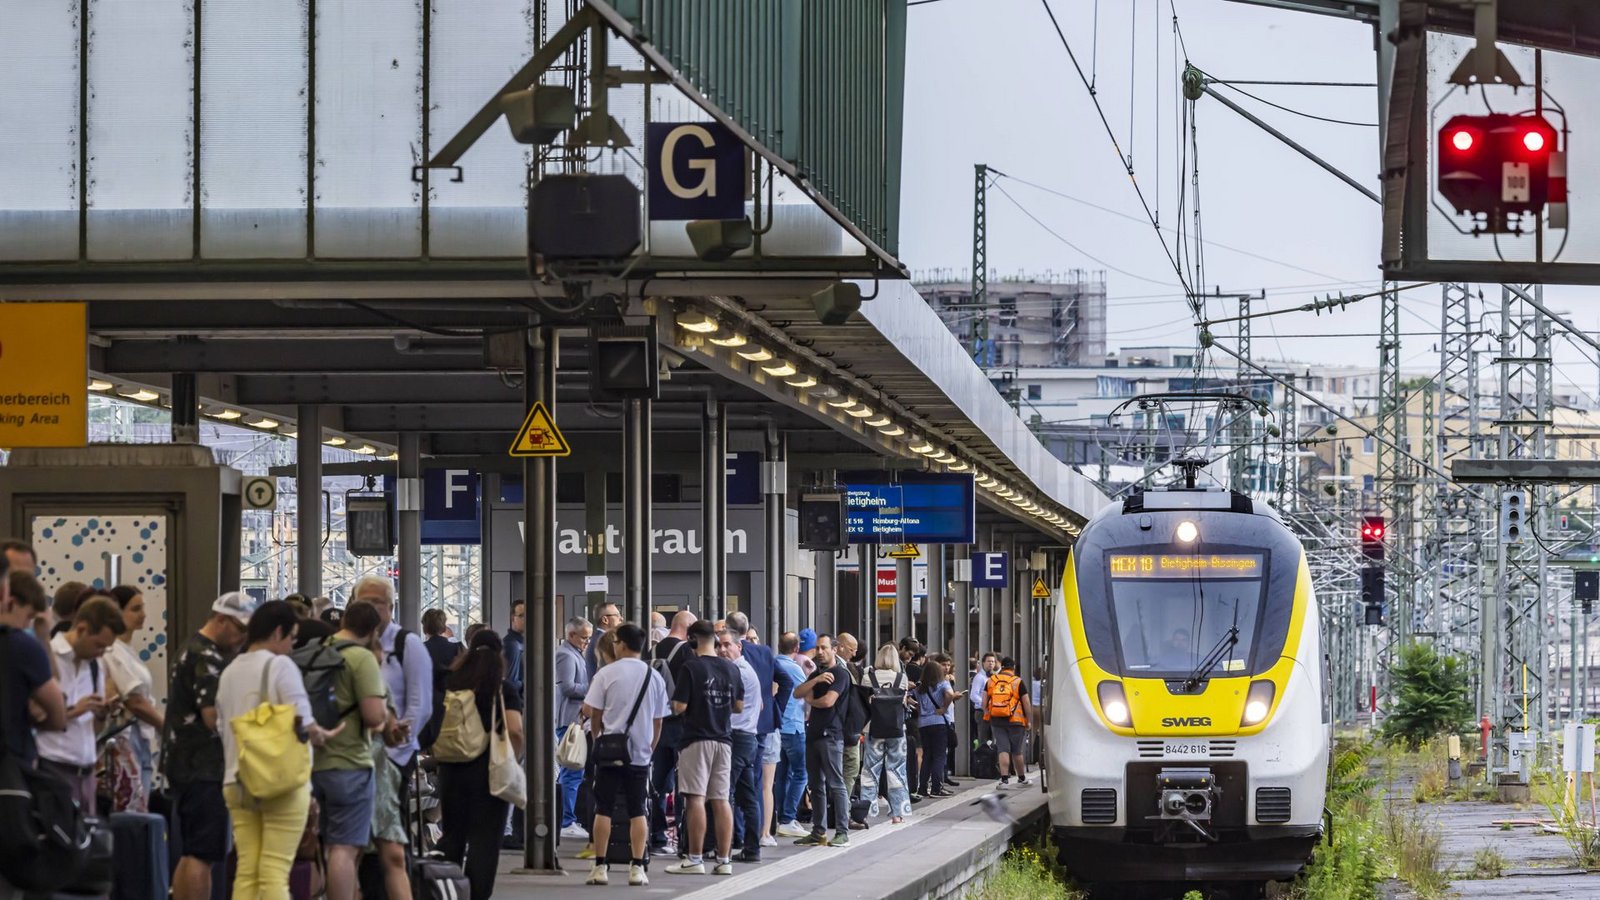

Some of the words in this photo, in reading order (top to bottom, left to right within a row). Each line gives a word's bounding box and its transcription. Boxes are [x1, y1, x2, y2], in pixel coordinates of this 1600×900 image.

[660, 124, 716, 199] G
[30, 412, 60, 424] Area
[445, 469, 469, 509] F
[847, 497, 887, 508] ietigheim
[985, 552, 1003, 580] E
[1111, 555, 1137, 572] MEX
[1140, 555, 1153, 572] 18
[1161, 716, 1212, 728] SWEG
[1165, 744, 1189, 754] 8442
[1190, 744, 1207, 754] 616
